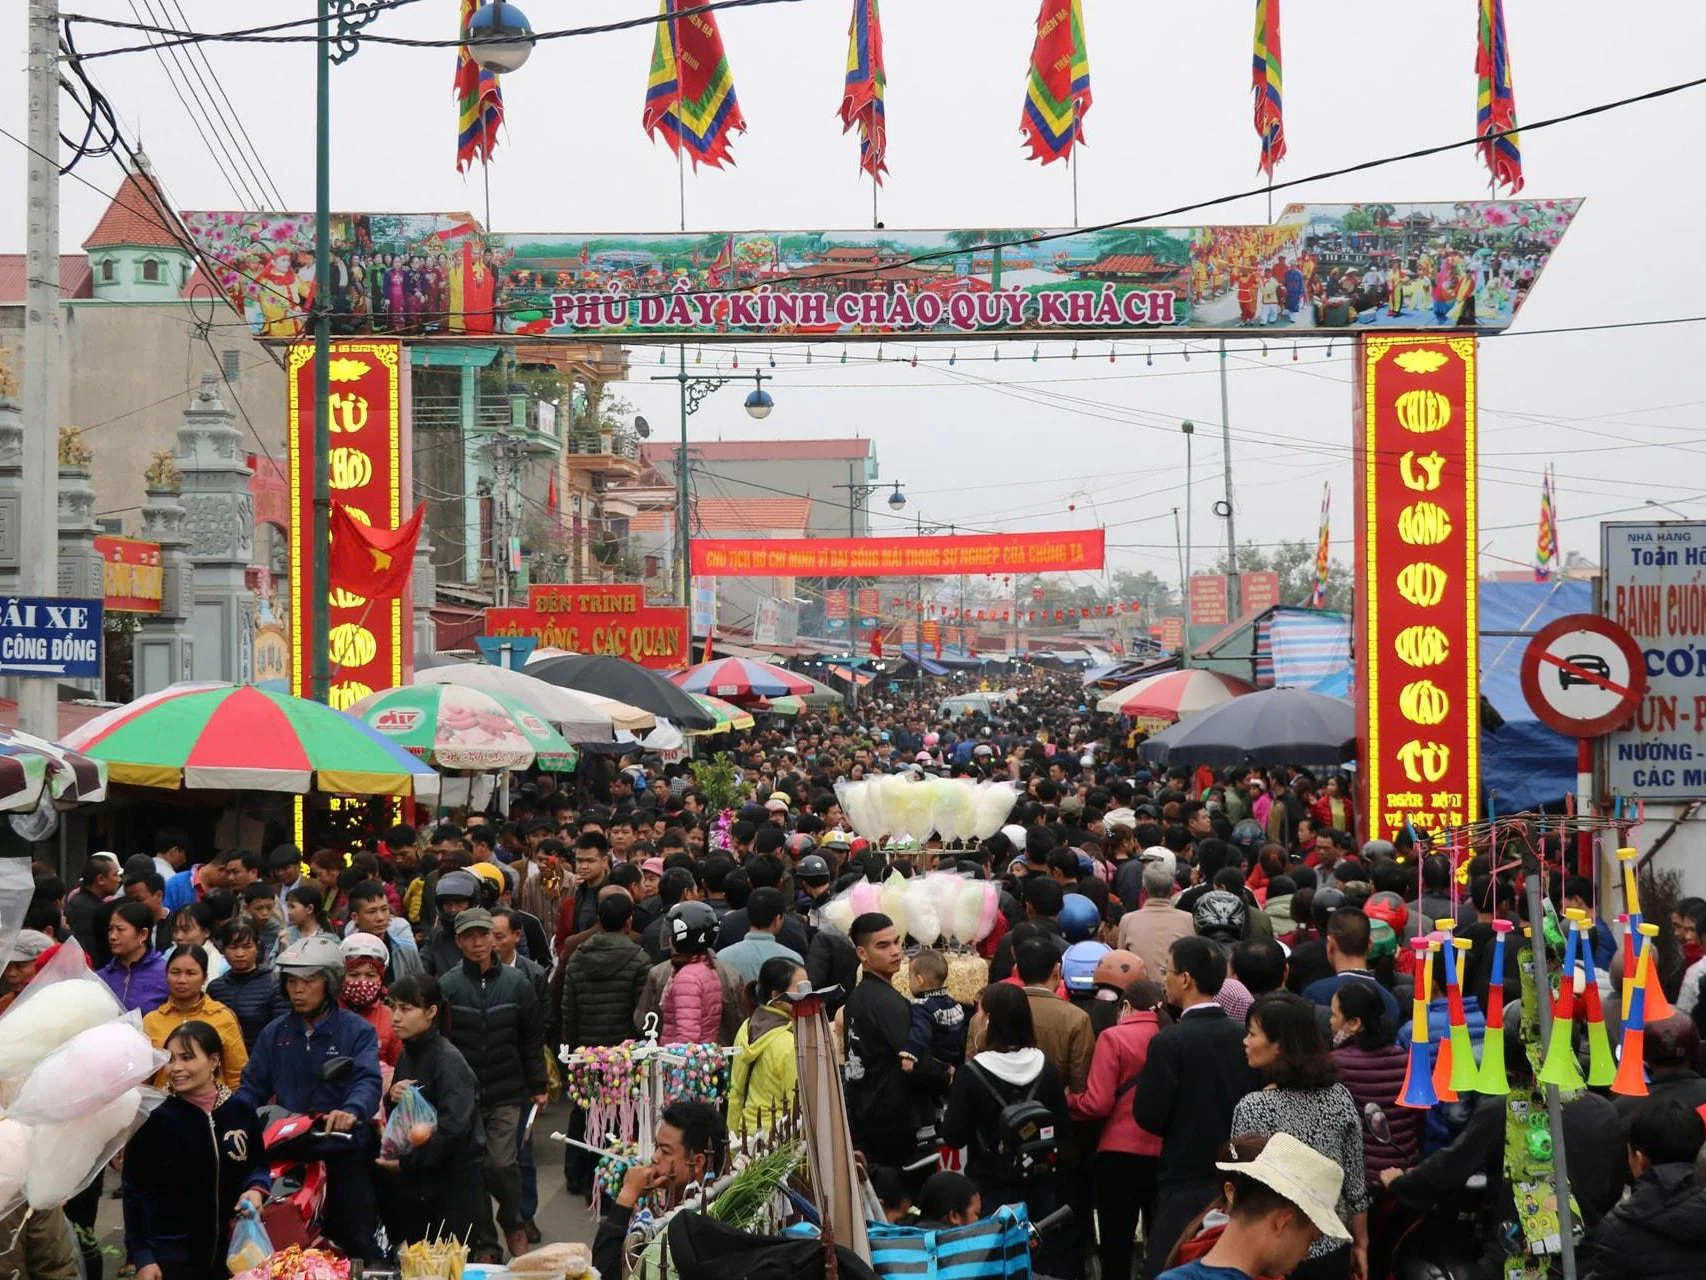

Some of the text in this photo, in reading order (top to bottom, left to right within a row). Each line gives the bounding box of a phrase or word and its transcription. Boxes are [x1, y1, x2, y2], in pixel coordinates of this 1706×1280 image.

[552, 282, 626, 325] PHỦ
[731, 286, 827, 325] KÍNH
[836, 283, 940, 325] CHÀO
[951, 285, 1030, 330] QUÝ
[1038, 283, 1175, 324] KHÁCH
[1395, 390, 1451, 434] THIÊN
[1657, 530, 1692, 542] HÀNG
[706, 544, 726, 568] CHỦ
[788, 550, 815, 568] MINH
[850, 545, 879, 567] SỐNG
[906, 548, 940, 566] TRONG
[961, 541, 1000, 567] NGHIỆP
[1028, 541, 1067, 562] CHÚNG
[1069, 543, 1084, 562] TA
[1631, 545, 1678, 566] Toàn
[0, 598, 88, 630] ÃI XE
[535, 587, 637, 613] ĐỀN TRÌNH
[1616, 575, 1661, 637] BÁNH
[2, 632, 97, 662] CÔNG ĐỒNG
[592, 619, 626, 657] CÁC
[629, 627, 680, 663] QUAN
[1395, 625, 1450, 668] QUỐC
[1618, 736, 1693, 761] NƯỚNG
[1633, 765, 1706, 787] CÁC M
